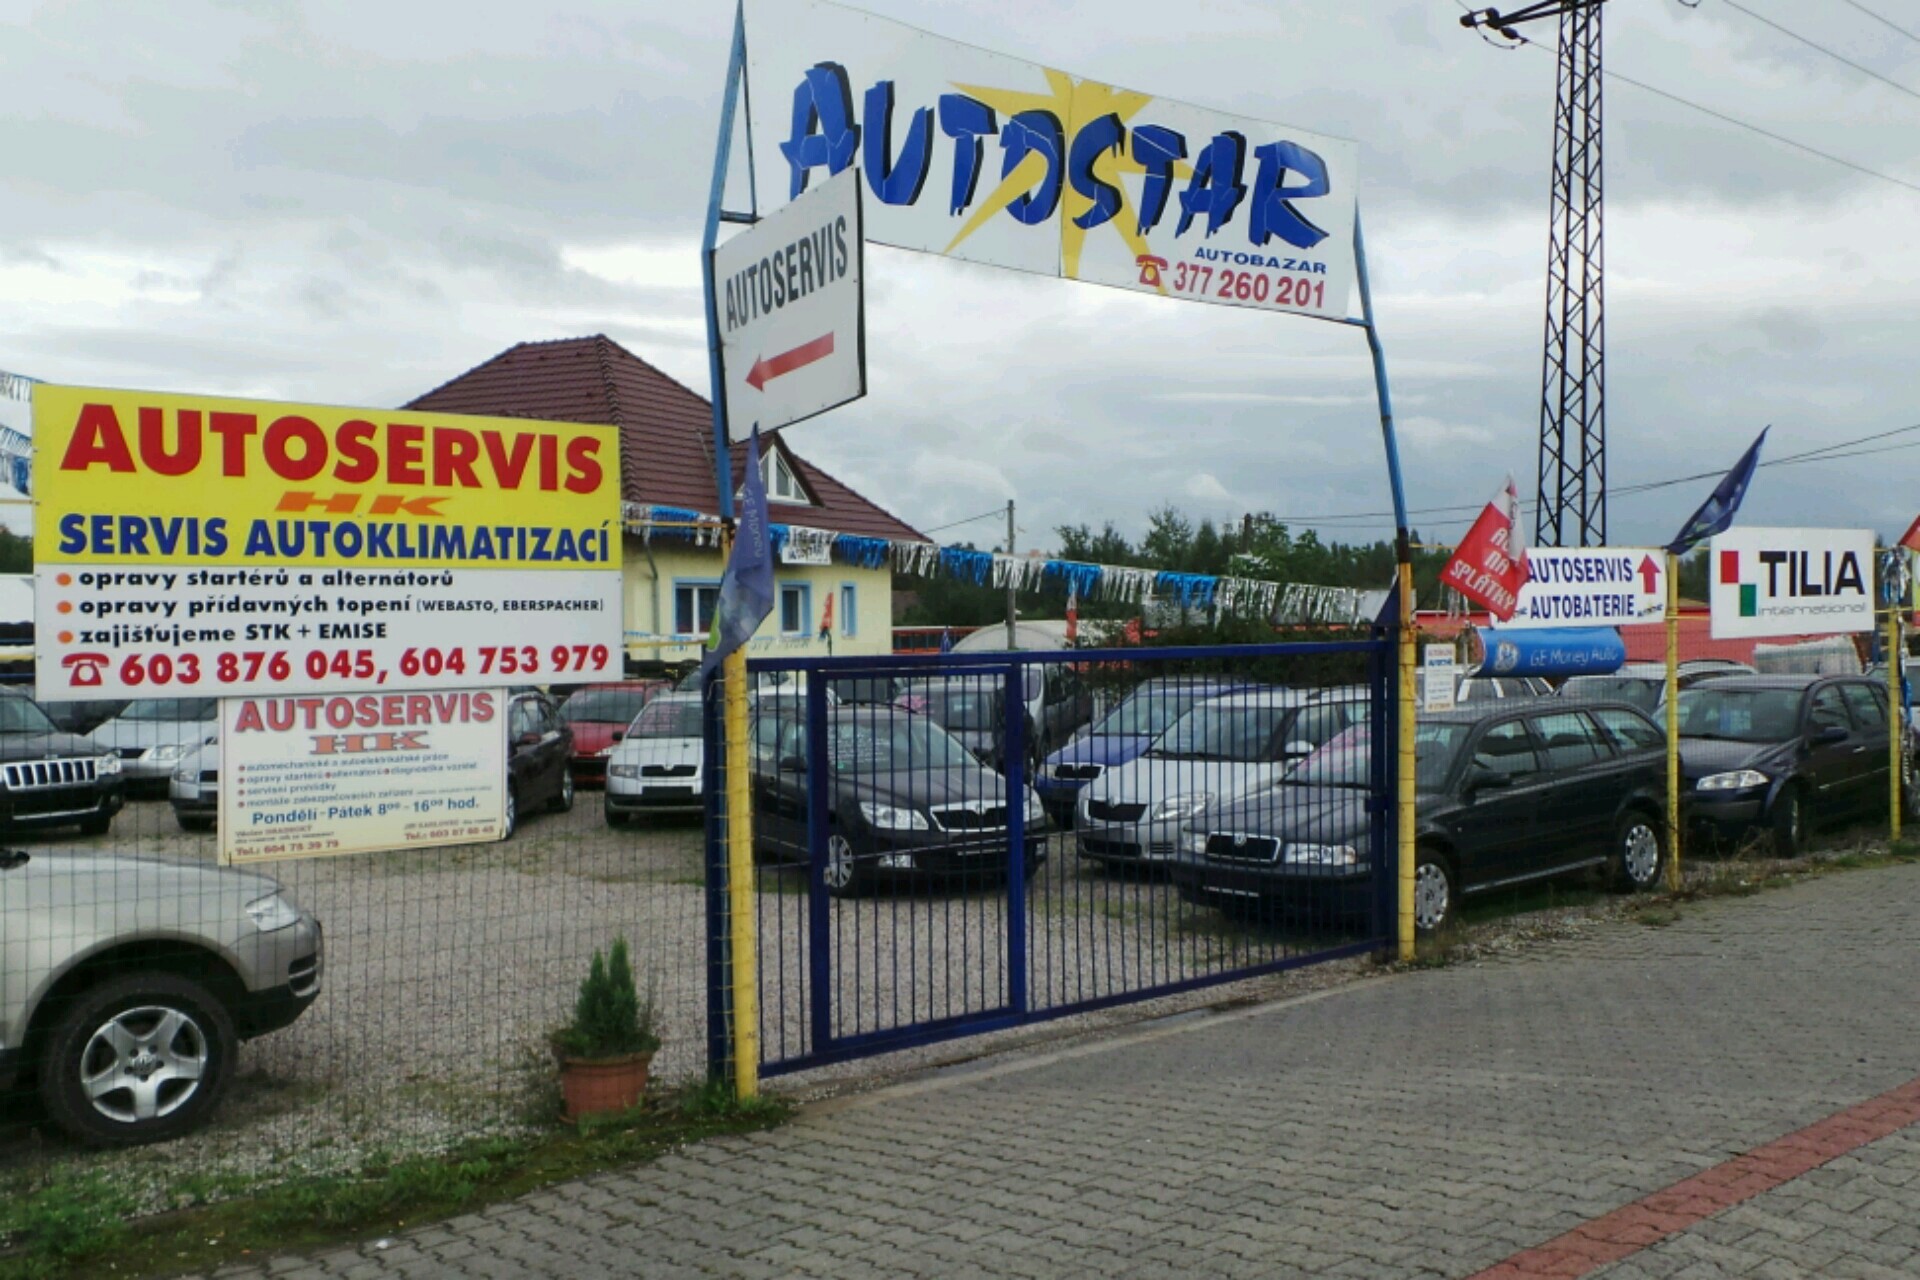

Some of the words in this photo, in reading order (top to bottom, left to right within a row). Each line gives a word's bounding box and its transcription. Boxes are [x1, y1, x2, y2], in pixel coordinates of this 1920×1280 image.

[726, 215, 848, 332] AUTOSERVIS
[1195, 247, 1326, 275] AUTOBAZAR
[1174, 261, 1213, 295] 377
[1218, 269, 1270, 303] 260
[1276, 276, 1324, 308] 201
[60, 403, 604, 494] AUTOSERVIS
[274, 491, 452, 517] HK
[59, 513, 228, 557] SERVIS
[244, 519, 610, 562] AUTOKLIMATIZACÍ
[79, 572, 177, 591] opravy
[187, 568, 288, 586] startérů
[299, 574, 312, 586] a
[322, 569, 453, 586] alternátorů
[1529, 557, 1633, 583] AUTOSERVIS
[1760, 551, 1865, 597] TILIA
[79, 600, 177, 618] opravy
[189, 595, 328, 618] přídavných
[337, 594, 410, 617] topení
[416, 599, 499, 613] (WEBASTO,
[502, 599, 604, 612] EBERSPACHER)
[1531, 594, 1634, 619] AUTOBATERIE
[1758, 602, 1866, 617] international
[80, 624, 235, 648] zajišťujeme
[245, 623, 290, 640] STK
[297, 626, 311, 638] +
[319, 623, 387, 640] EMISE
[119, 653, 201, 686] 603
[216, 650, 291, 682] 876
[305, 649, 388, 685] 045,
[400, 647, 465, 677] 604
[478, 646, 539, 675] 753
[551, 643, 609, 672] 979
[234, 692, 495, 733] AUTOSERVIS
[309, 731, 430, 755] HK
[252, 808, 317, 825] Pondělí
[328, 802, 373, 819] Pátek
[447, 796, 480, 810] hod.
